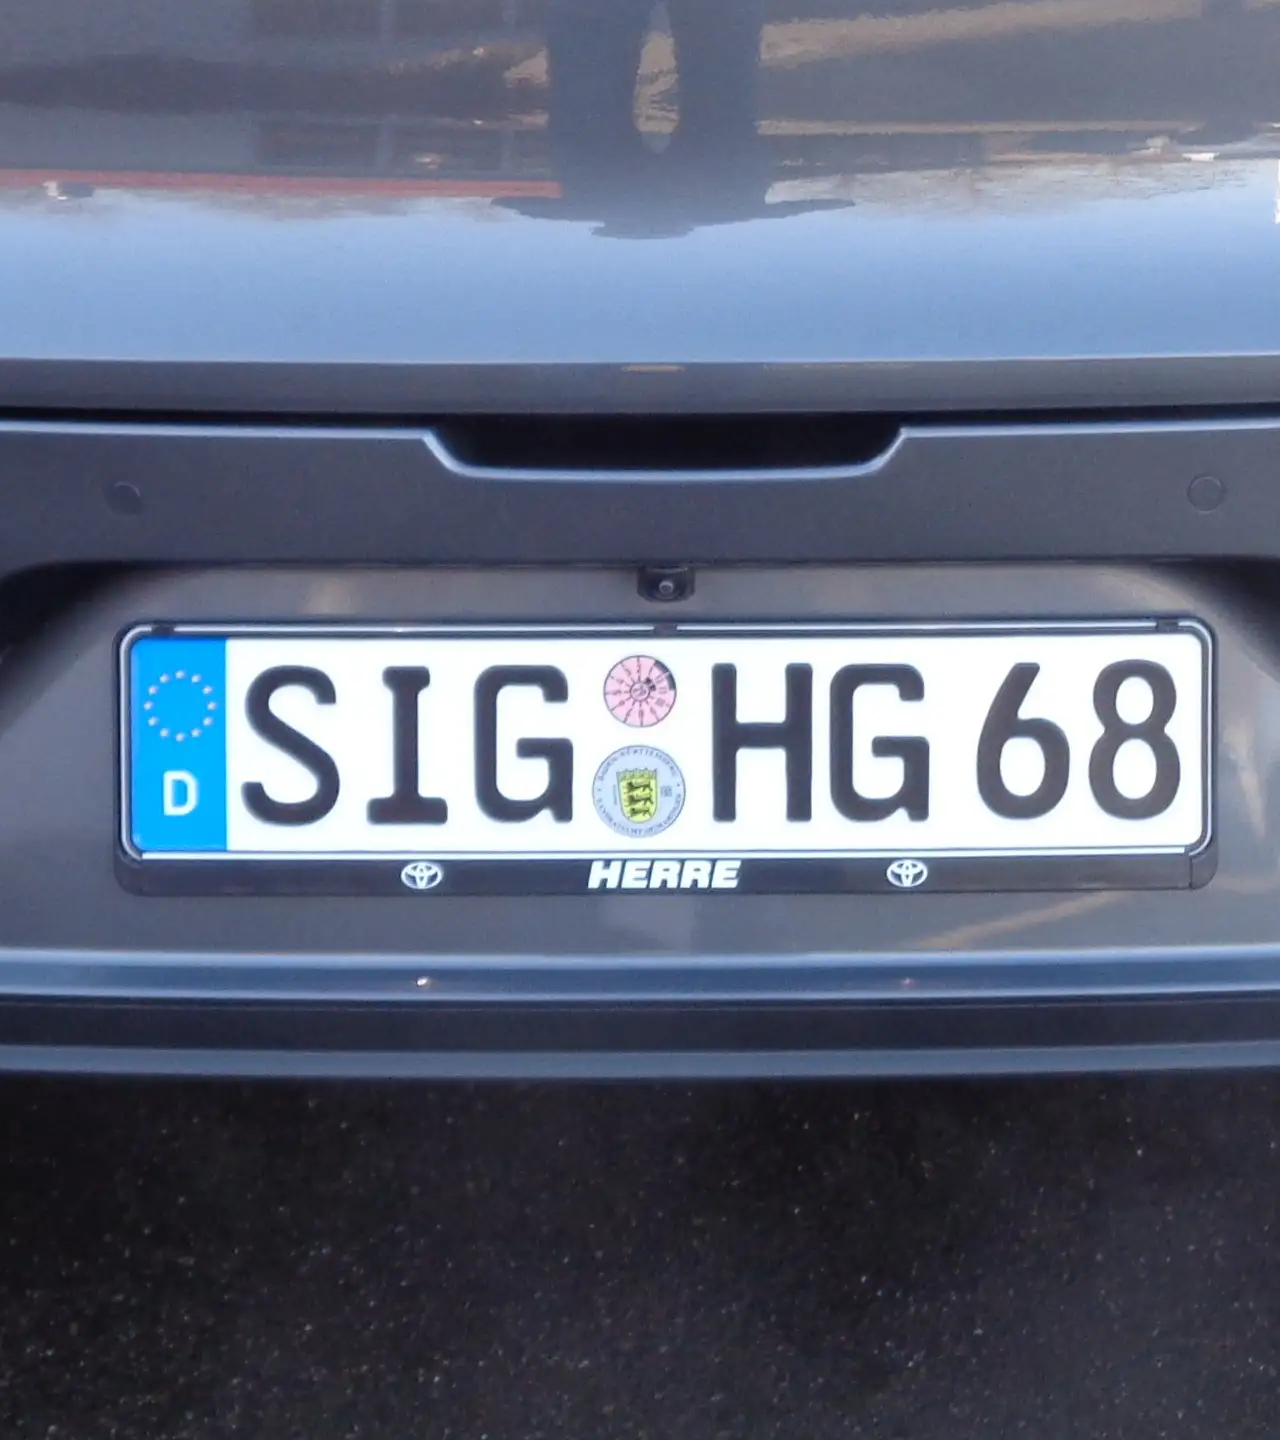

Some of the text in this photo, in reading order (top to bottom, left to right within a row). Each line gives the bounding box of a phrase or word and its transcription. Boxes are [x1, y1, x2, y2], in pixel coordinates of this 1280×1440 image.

[243, 663, 574, 827] SIG
[710, 661, 931, 824] HG
[974, 657, 1182, 822] 68
[162, 770, 197, 817] D
[587, 859, 743, 889] HERRE
